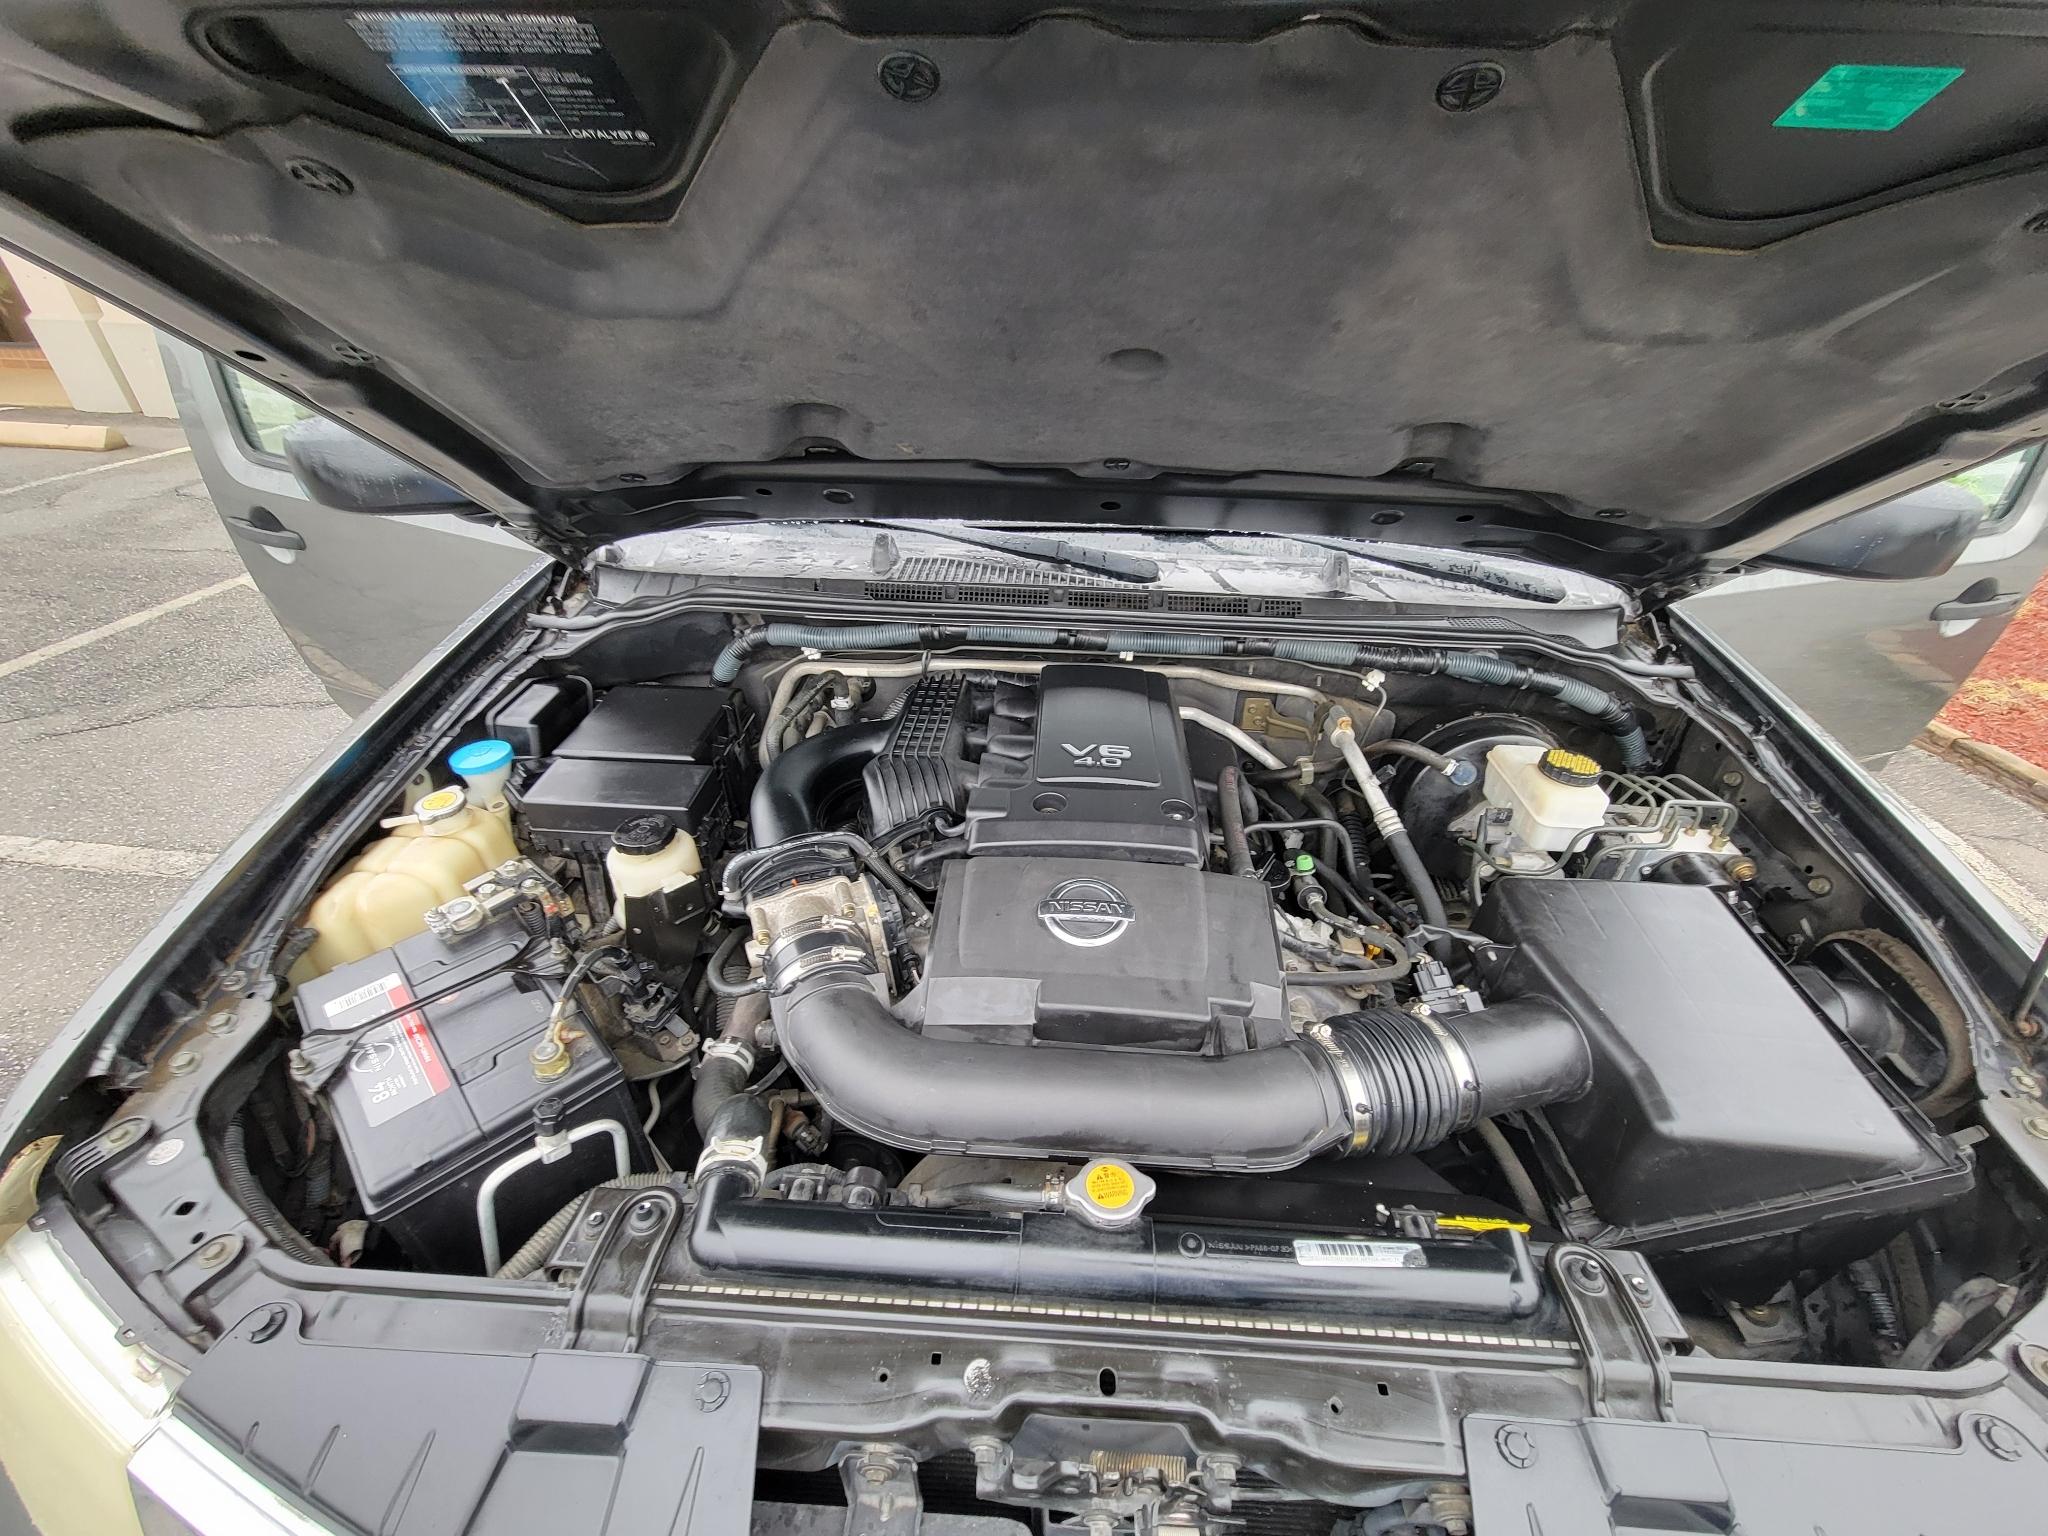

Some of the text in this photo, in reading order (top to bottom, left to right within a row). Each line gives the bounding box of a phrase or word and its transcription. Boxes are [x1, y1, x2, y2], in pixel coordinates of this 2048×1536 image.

[353, 12, 577, 24] VEHICLE EMISSION CONTROL INFORMATION
[571, 129, 633, 139] CATALYST
[1061, 743, 1132, 759] V6
[1073, 756, 1122, 768] 4.0
[1048, 901, 1125, 914] NISSAN
[363, 1044, 383, 1072] NISSAN
[367, 1081, 390, 1103] 84
